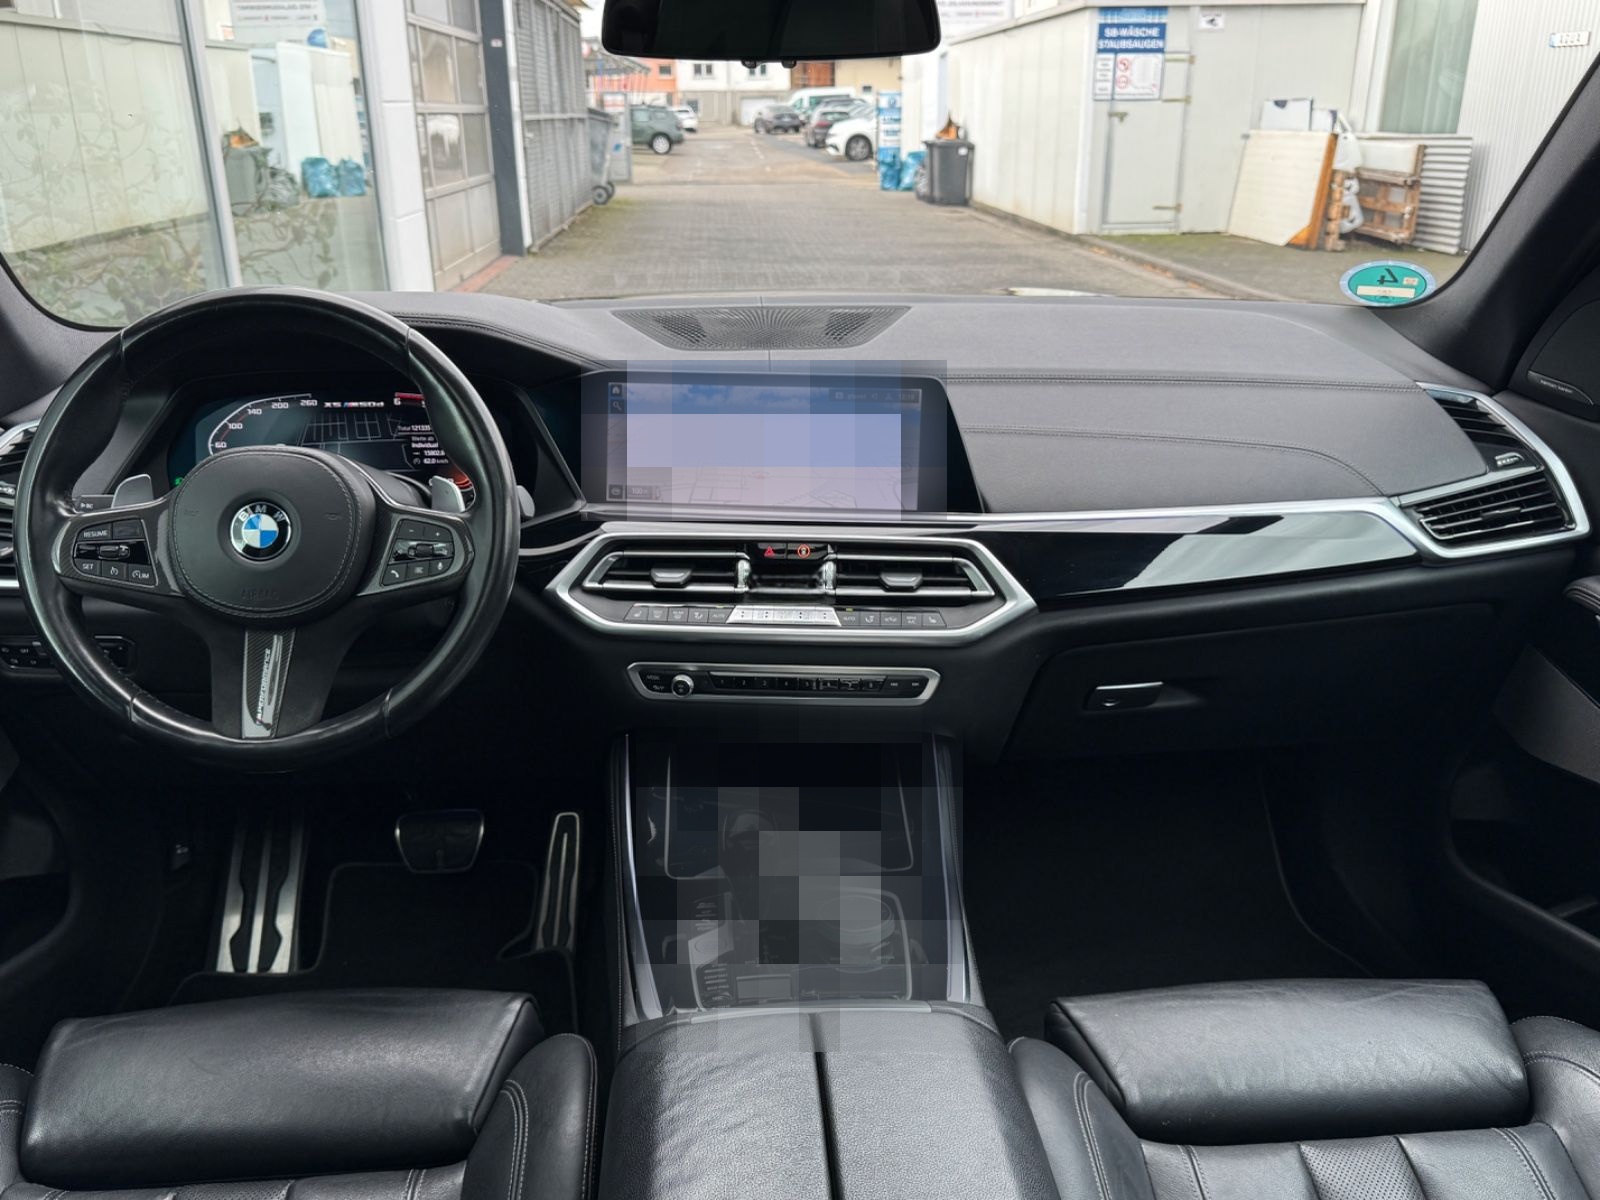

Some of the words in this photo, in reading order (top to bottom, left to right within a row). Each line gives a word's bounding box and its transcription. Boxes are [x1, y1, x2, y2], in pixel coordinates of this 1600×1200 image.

[1103, 26, 1160, 38] SB-WÄSCHE
[1098, 39, 1164, 49] STAUBSAUGEN
[238, 504, 287, 522] BMW
[83, 530, 108, 538] RESUME
